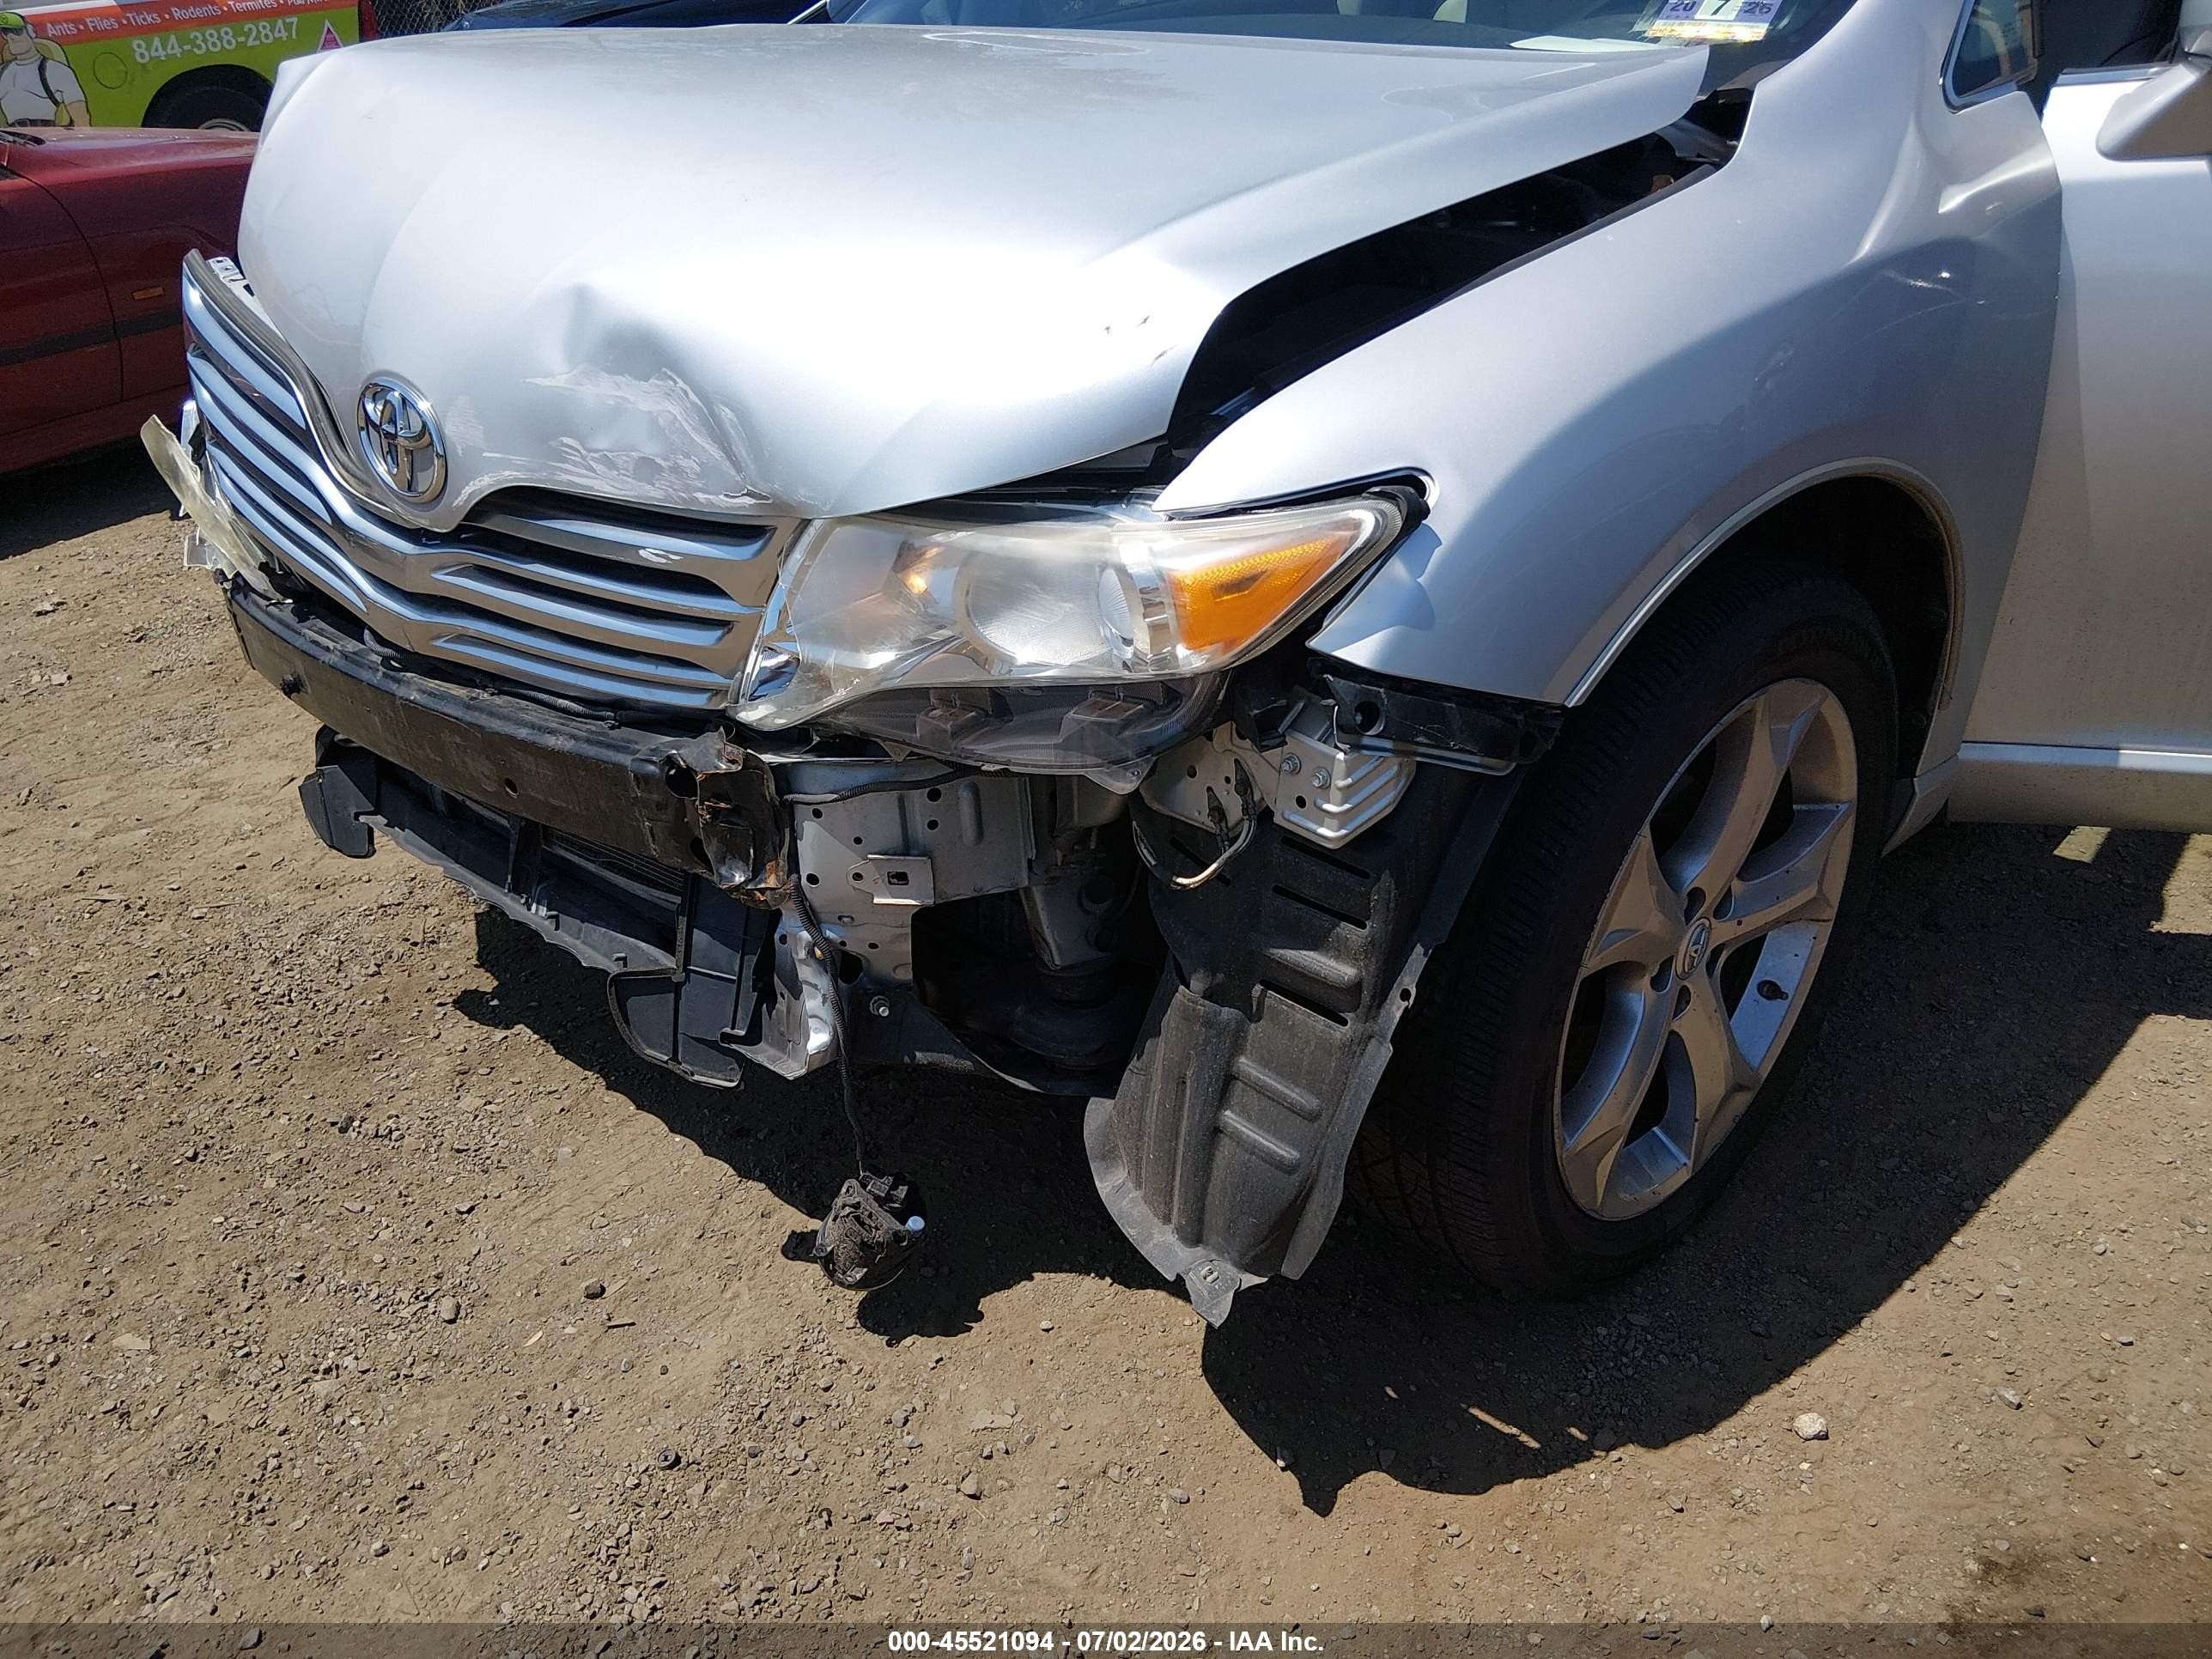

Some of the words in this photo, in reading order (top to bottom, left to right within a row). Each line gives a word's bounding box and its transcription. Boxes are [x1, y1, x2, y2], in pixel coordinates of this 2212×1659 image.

[46, 22, 78, 37] Ants
[85, 16, 118, 32] Flies
[126, 11, 161, 27] Ticks
[171, 3, 222, 21] Rodents
[228, 0, 277, 13] Termites
[132, 16, 299, 64] 844-388-2847
